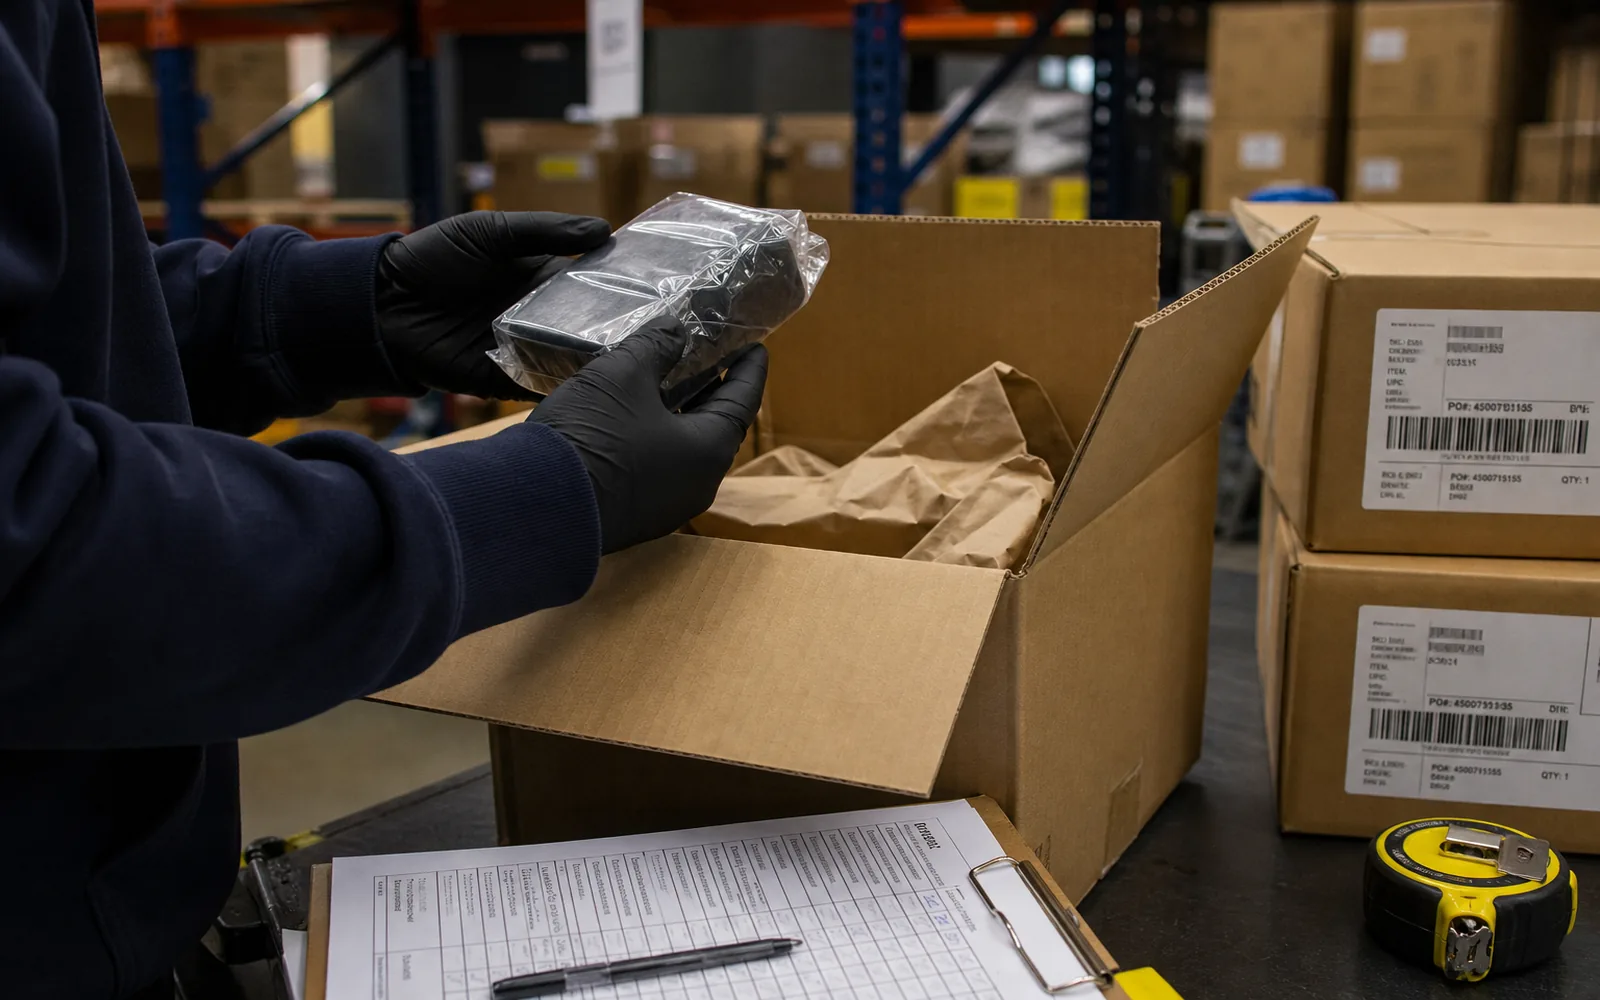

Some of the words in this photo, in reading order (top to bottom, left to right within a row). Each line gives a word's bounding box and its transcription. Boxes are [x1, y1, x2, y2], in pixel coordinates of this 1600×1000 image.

[1447, 401, 1471, 412] PO#:
[1561, 475, 1582, 485] QTY:
[1585, 476, 1590, 484] 1
[1541, 771, 1562, 781] QTY:
[1564, 772, 1569, 781] 1
